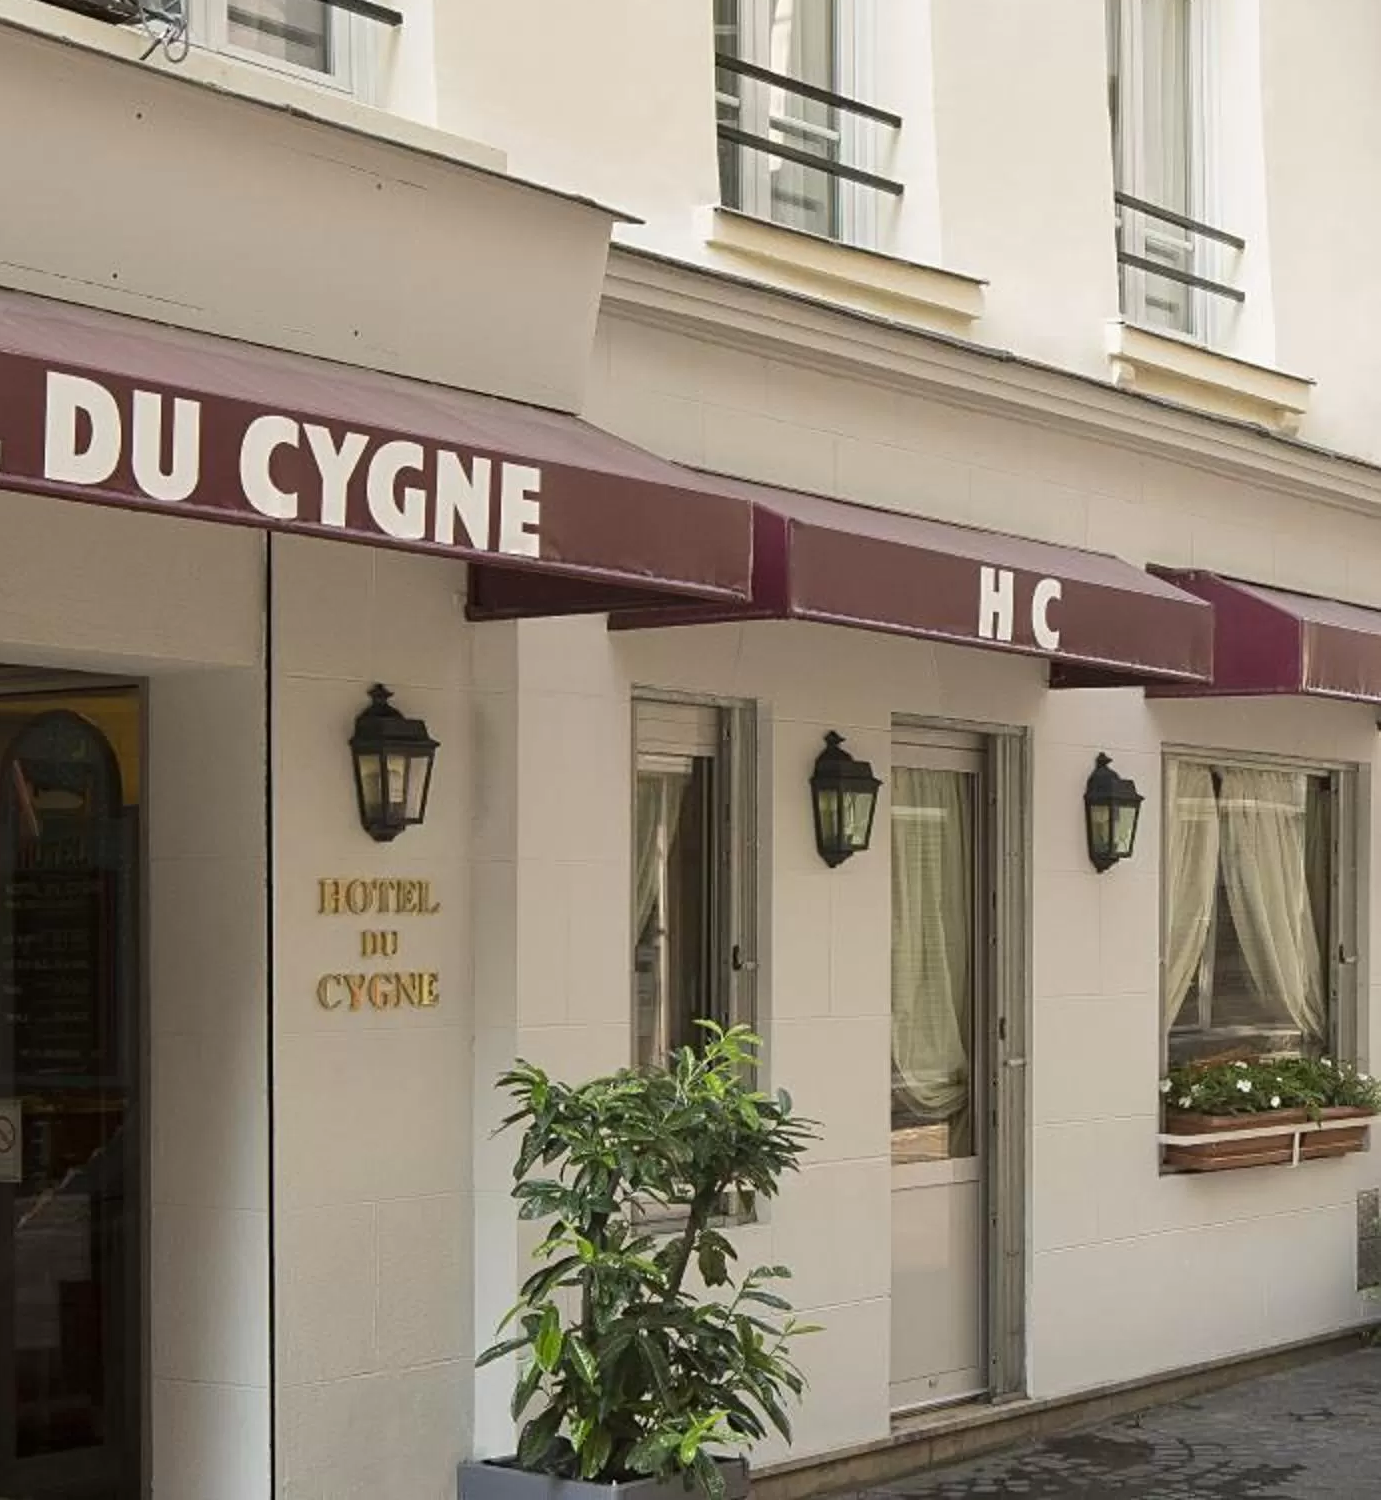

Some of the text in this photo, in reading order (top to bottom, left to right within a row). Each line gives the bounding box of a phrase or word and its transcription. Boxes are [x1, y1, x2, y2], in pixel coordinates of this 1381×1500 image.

[44, 370, 201, 502] DU
[239, 414, 541, 559] CYGNE
[316, 877, 441, 915] HOTEL
[360, 930, 399, 957] DU
[316, 971, 441, 1011] CYGNE
